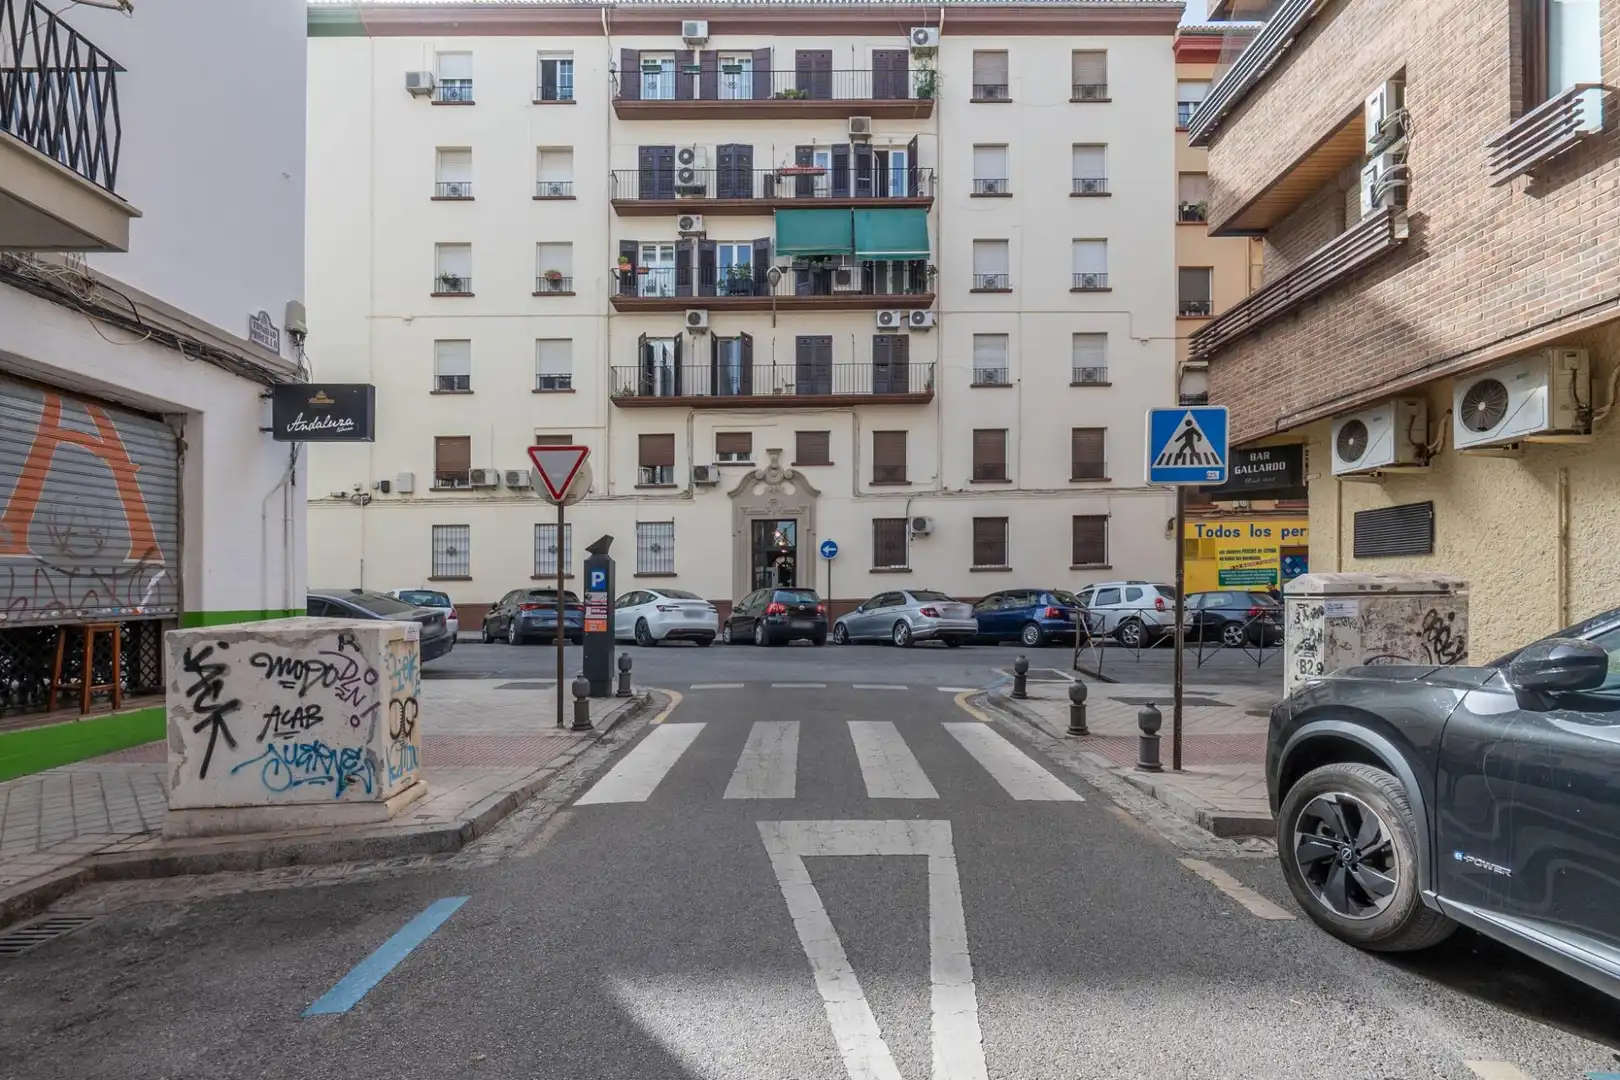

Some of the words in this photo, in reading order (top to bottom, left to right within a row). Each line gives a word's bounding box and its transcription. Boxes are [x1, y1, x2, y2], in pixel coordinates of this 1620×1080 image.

[286, 412, 354, 432] Andaluza
[1250, 451, 1271, 461] BAR
[1234, 461, 1286, 475] GALLARDO
[1194, 523, 1241, 538] Todos
[1249, 523, 1272, 538] los
[1281, 527, 1309, 541] per
[591, 571, 605, 588] P
[256, 704, 324, 743] ACAB
